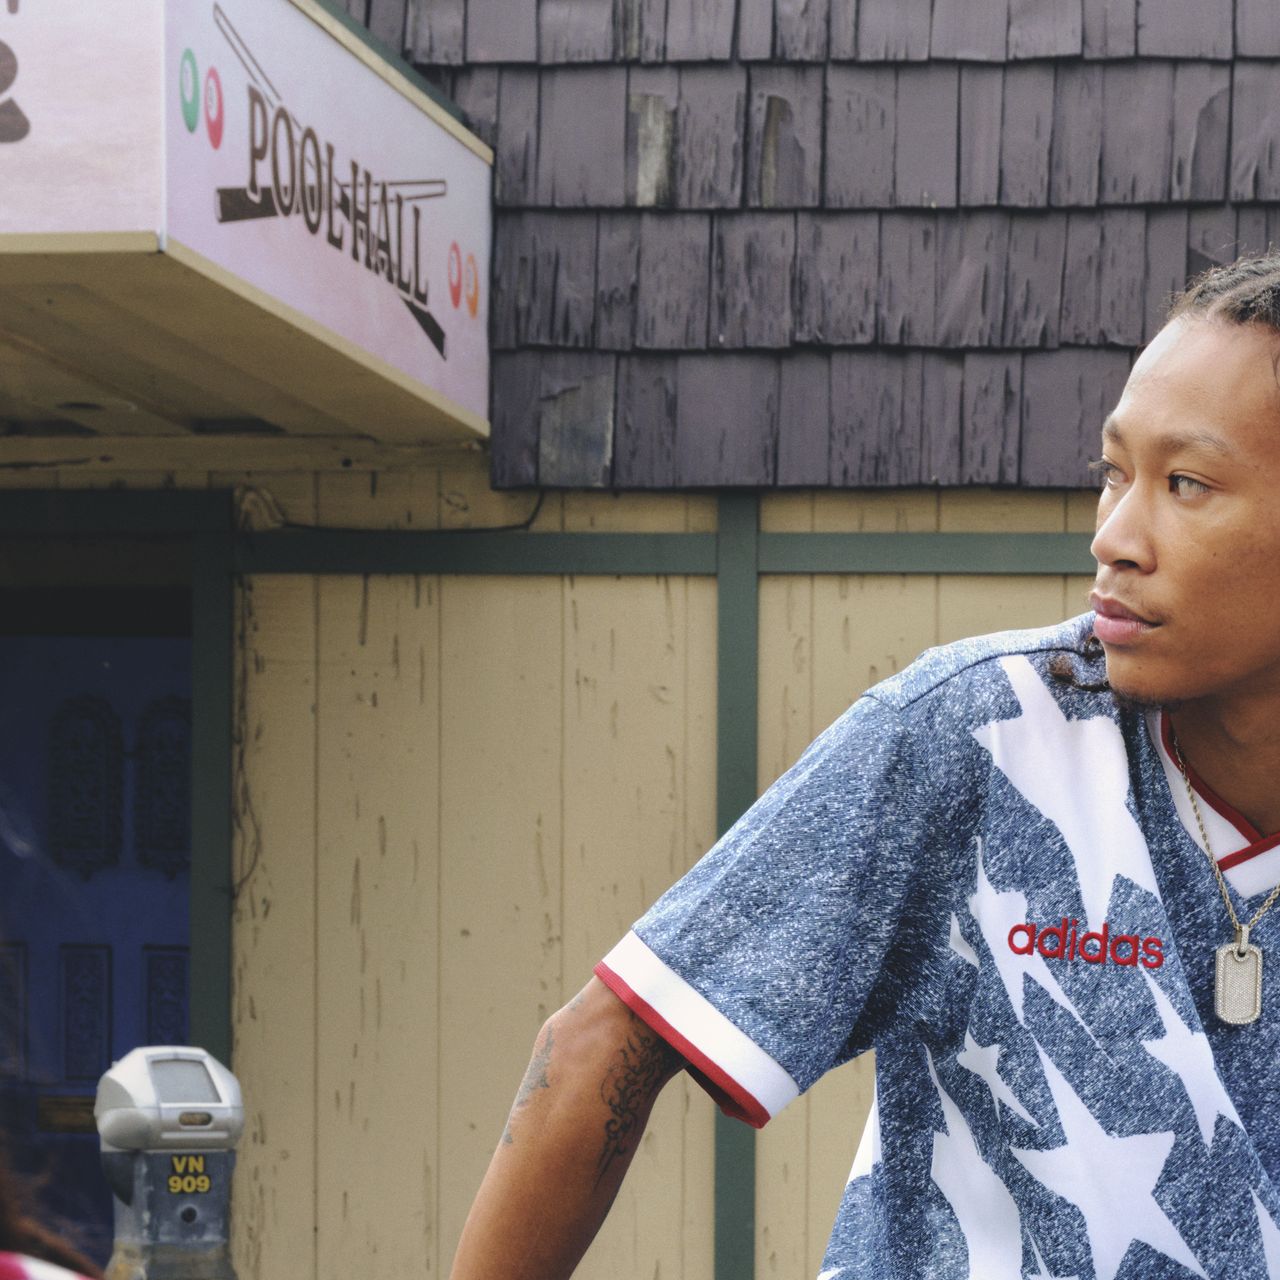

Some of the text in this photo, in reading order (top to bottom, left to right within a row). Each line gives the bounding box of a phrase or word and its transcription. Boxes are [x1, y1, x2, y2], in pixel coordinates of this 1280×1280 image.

[247, 84, 429, 305] POOL HALL
[1008, 917, 1164, 969] adidas
[172, 1155, 204, 1173] VN
[168, 1175, 210, 1193] 909
